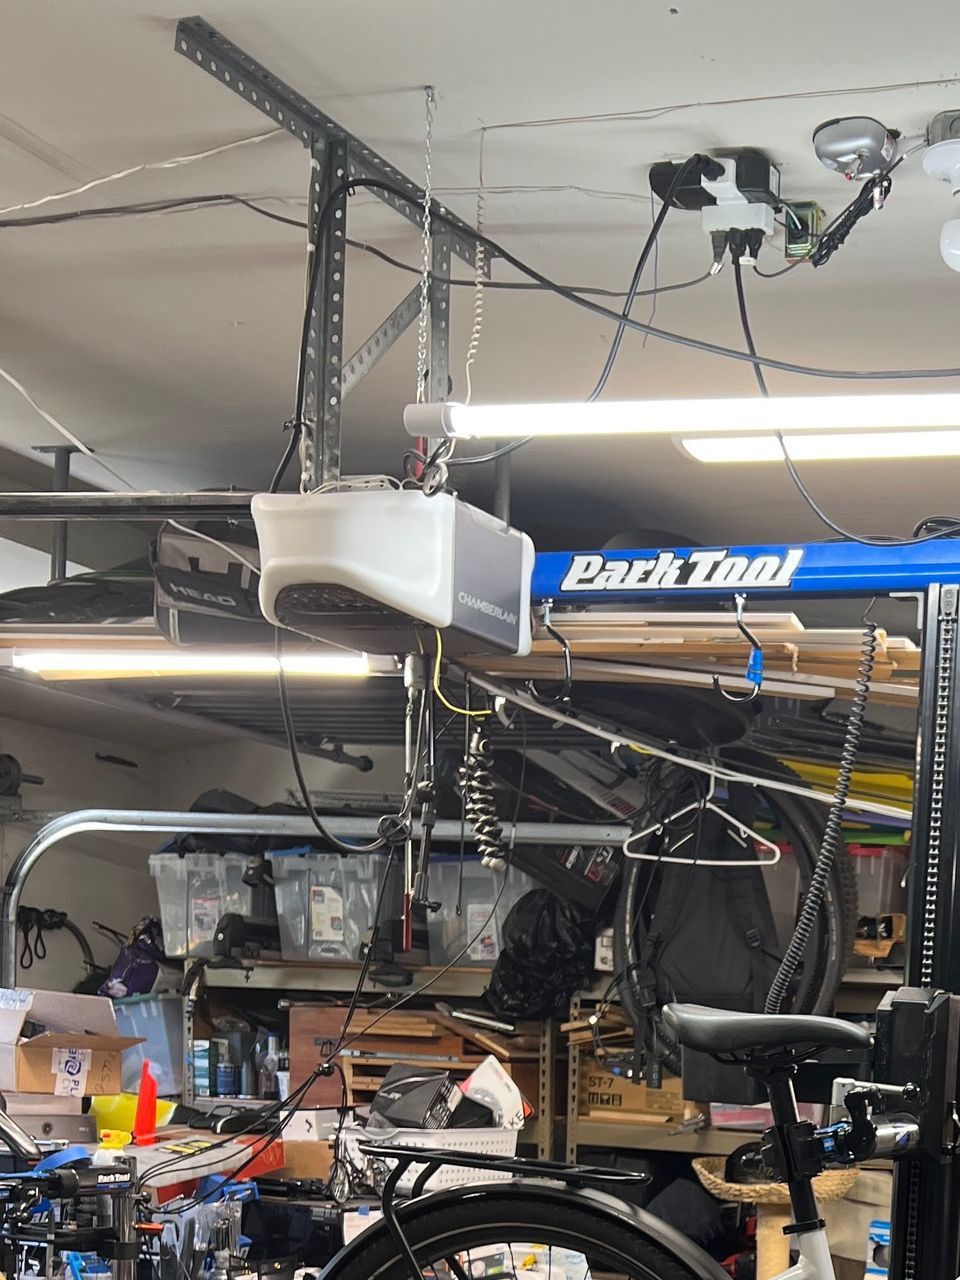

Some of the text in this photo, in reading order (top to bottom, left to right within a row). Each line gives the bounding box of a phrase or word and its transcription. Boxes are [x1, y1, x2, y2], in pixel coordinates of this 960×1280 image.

[169, 582, 237, 607] HEAD
[457, 591, 518, 626] CHAMBERLAIN
[588, 1075, 615, 1089] ST-7
